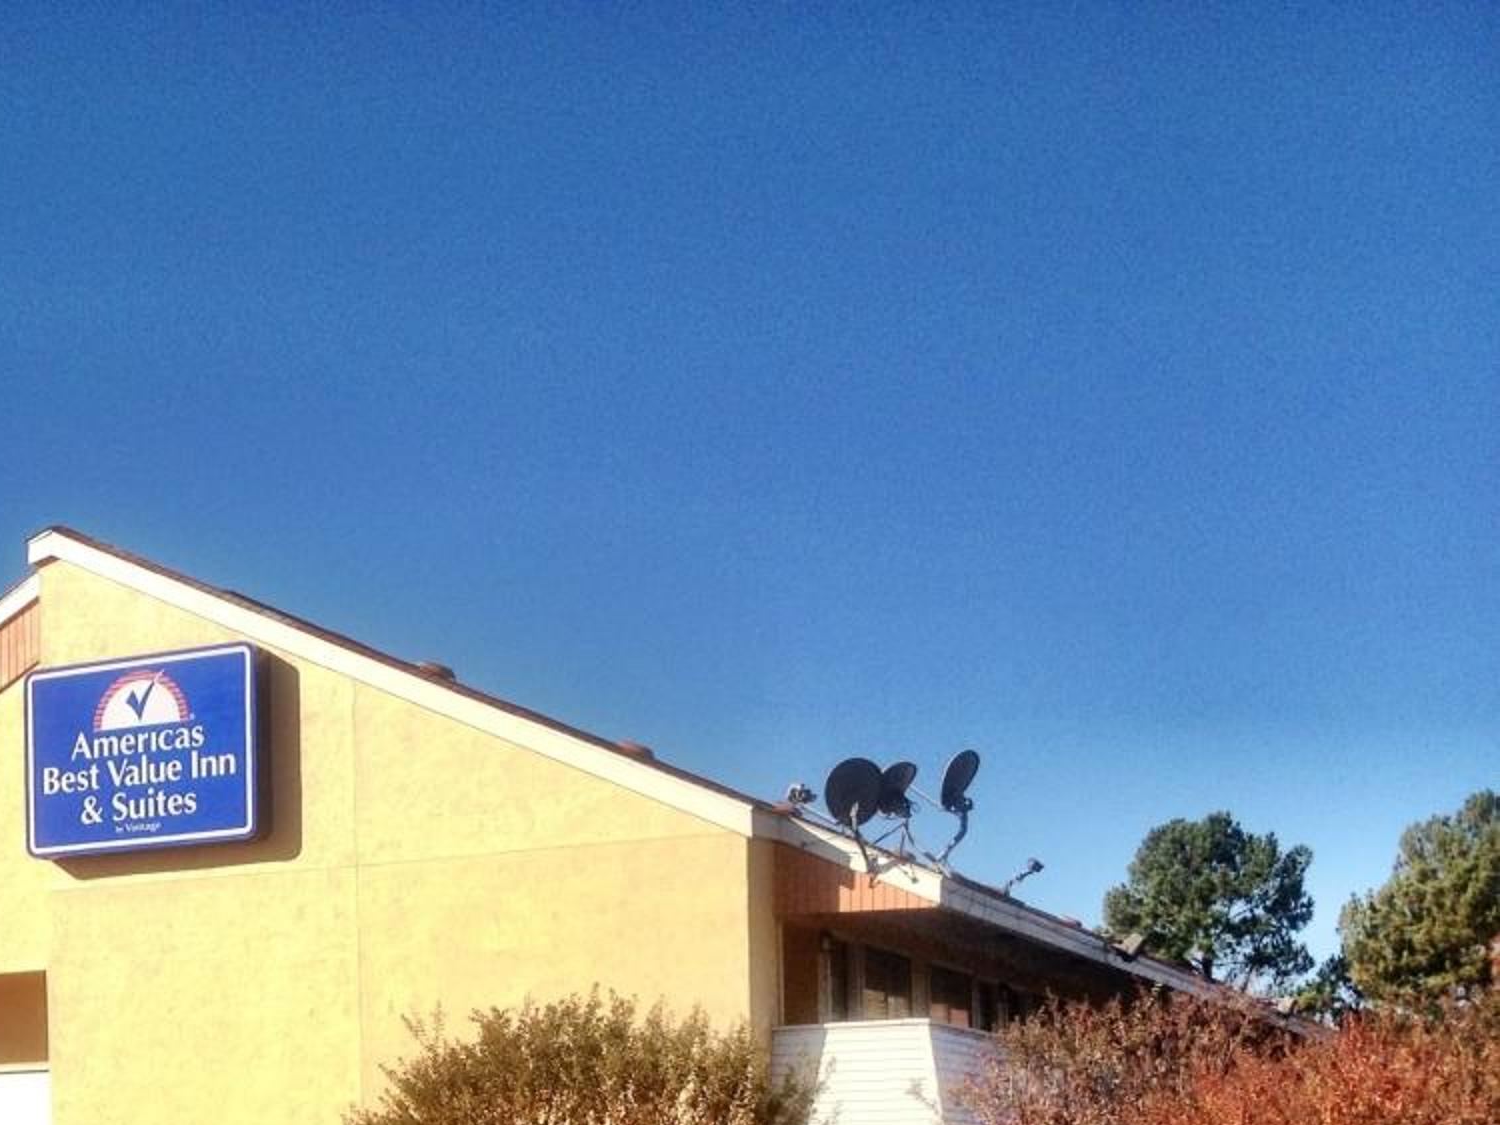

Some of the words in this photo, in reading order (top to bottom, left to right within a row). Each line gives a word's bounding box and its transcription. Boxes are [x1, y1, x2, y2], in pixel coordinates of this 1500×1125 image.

[71, 725, 205, 761] Americas
[43, 763, 100, 796] Best
[107, 755, 182, 787] Value
[191, 751, 236, 779] Inn
[80, 795, 103, 825] &
[112, 788, 197, 822] Suites
